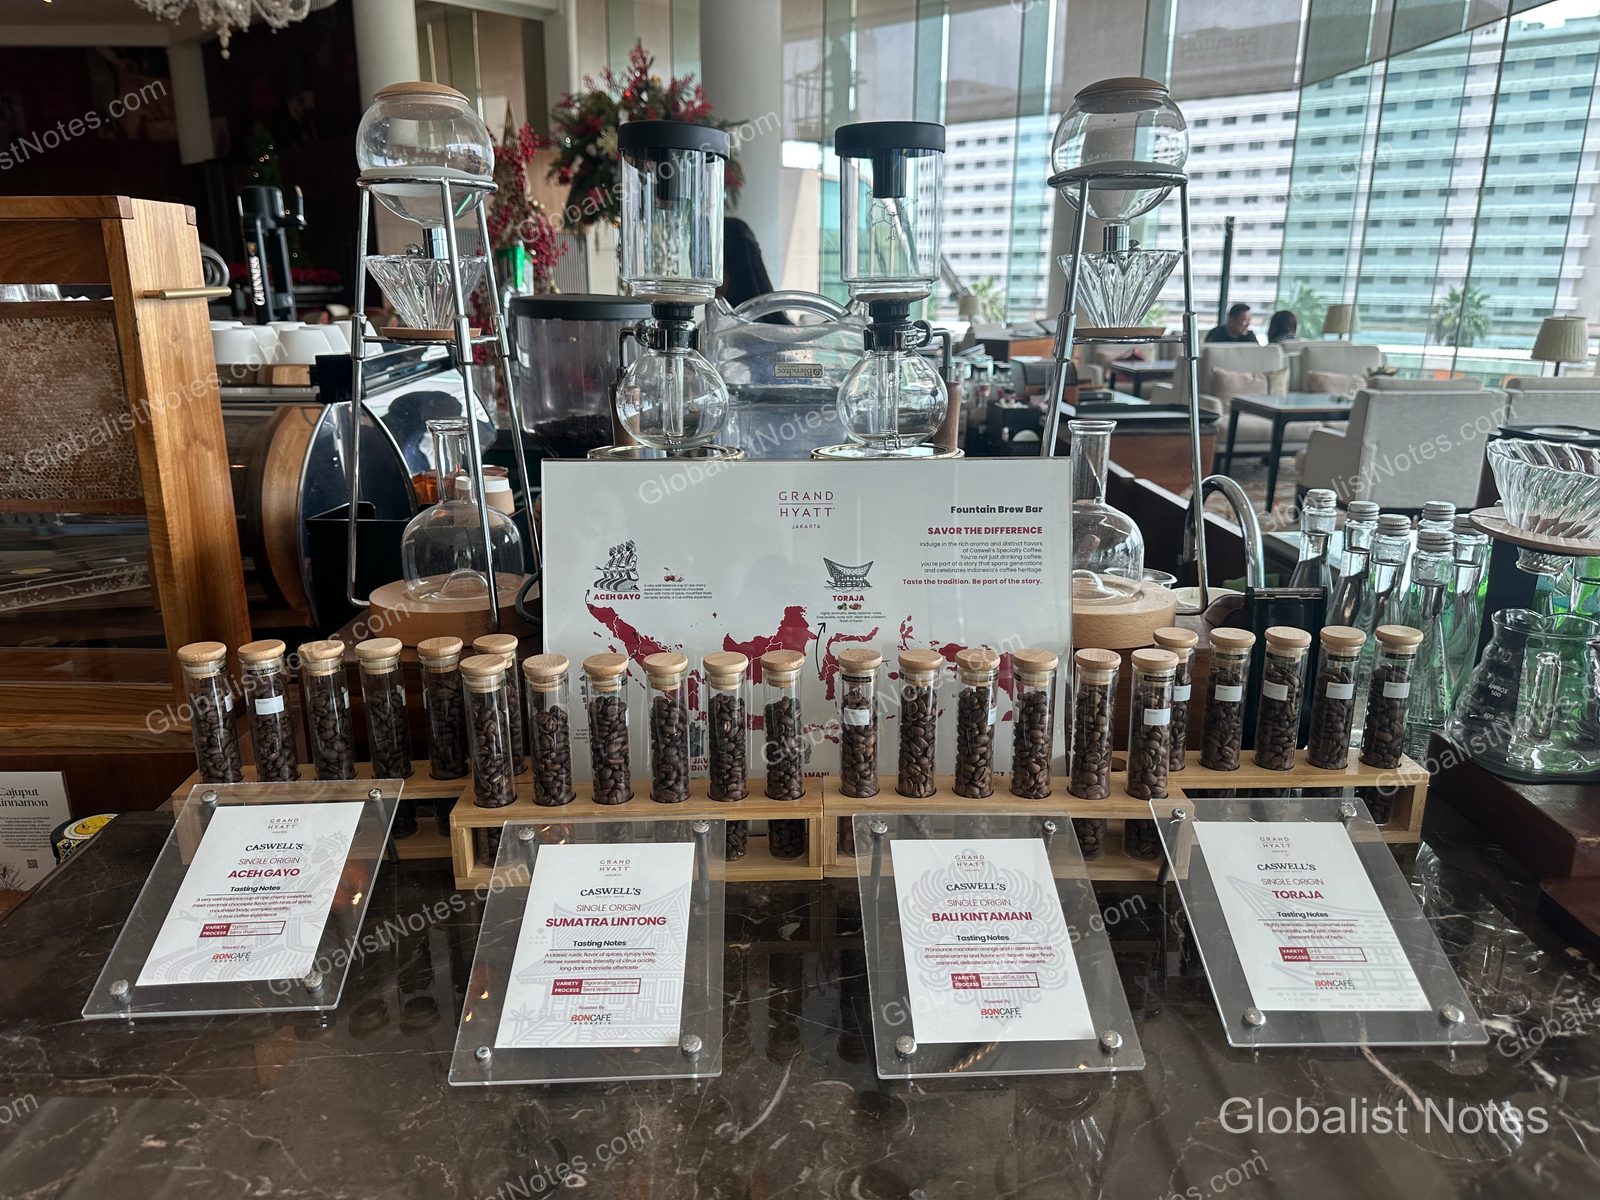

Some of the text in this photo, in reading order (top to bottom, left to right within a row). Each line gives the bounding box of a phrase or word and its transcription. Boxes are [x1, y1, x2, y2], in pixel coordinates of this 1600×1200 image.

[778, 491, 834, 501] GRAND
[780, 507, 834, 517] HYATT
[950, 505, 1043, 513] Fountain Brew Bar
[927, 527, 1043, 535] SAVOR THE DIFFERENCE
[982, 578, 998, 586] part
[1021, 578, 1042, 586] story.
[0, 798, 49, 807] innamon
[245, 842, 304, 851] CASWELL'S
[1257, 862, 1317, 871] CASWELL'S
[228, 868, 300, 878] ACEH GAYO
[946, 882, 1006, 891] CASWELL'S
[1261, 878, 1324, 886] SINGLE ORIGIN
[580, 887, 641, 896] CASWELL'S
[1271, 890, 1325, 899] TORAJA
[947, 899, 978, 907] SINGLE
[576, 904, 641, 912] SINGLE ORIGIN
[931, 911, 1032, 921] BALI KINTAMANI
[1276, 911, 1307, 919] Tasting
[545, 916, 667, 927] SUMATRA LINTONG
[956, 935, 986, 943] Tasting
[573, 940, 602, 948] Tasting
